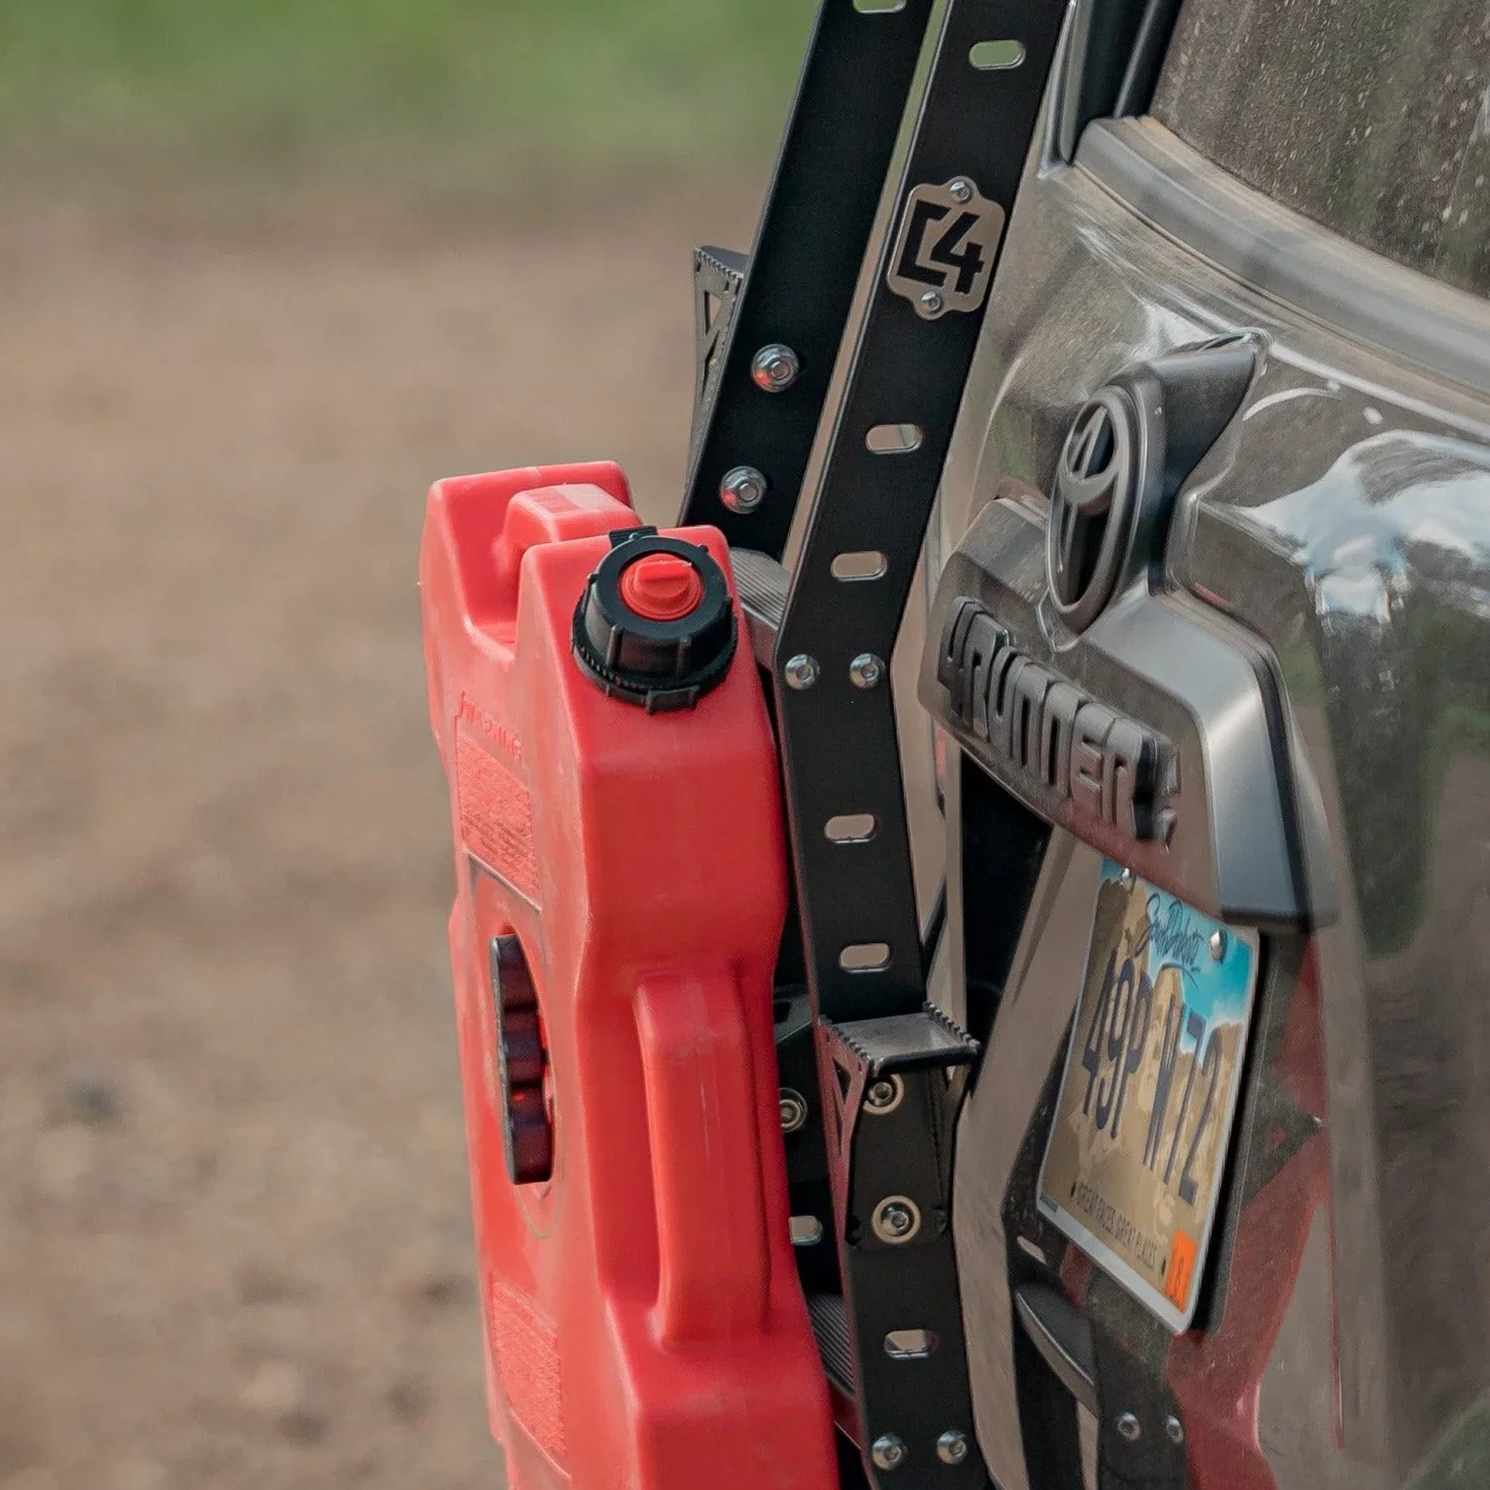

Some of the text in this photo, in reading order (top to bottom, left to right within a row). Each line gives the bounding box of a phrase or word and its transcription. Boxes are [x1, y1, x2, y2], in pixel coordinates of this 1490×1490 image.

[896, 199, 985, 296] C4
[1082, 944, 1223, 1207] 49P W72
